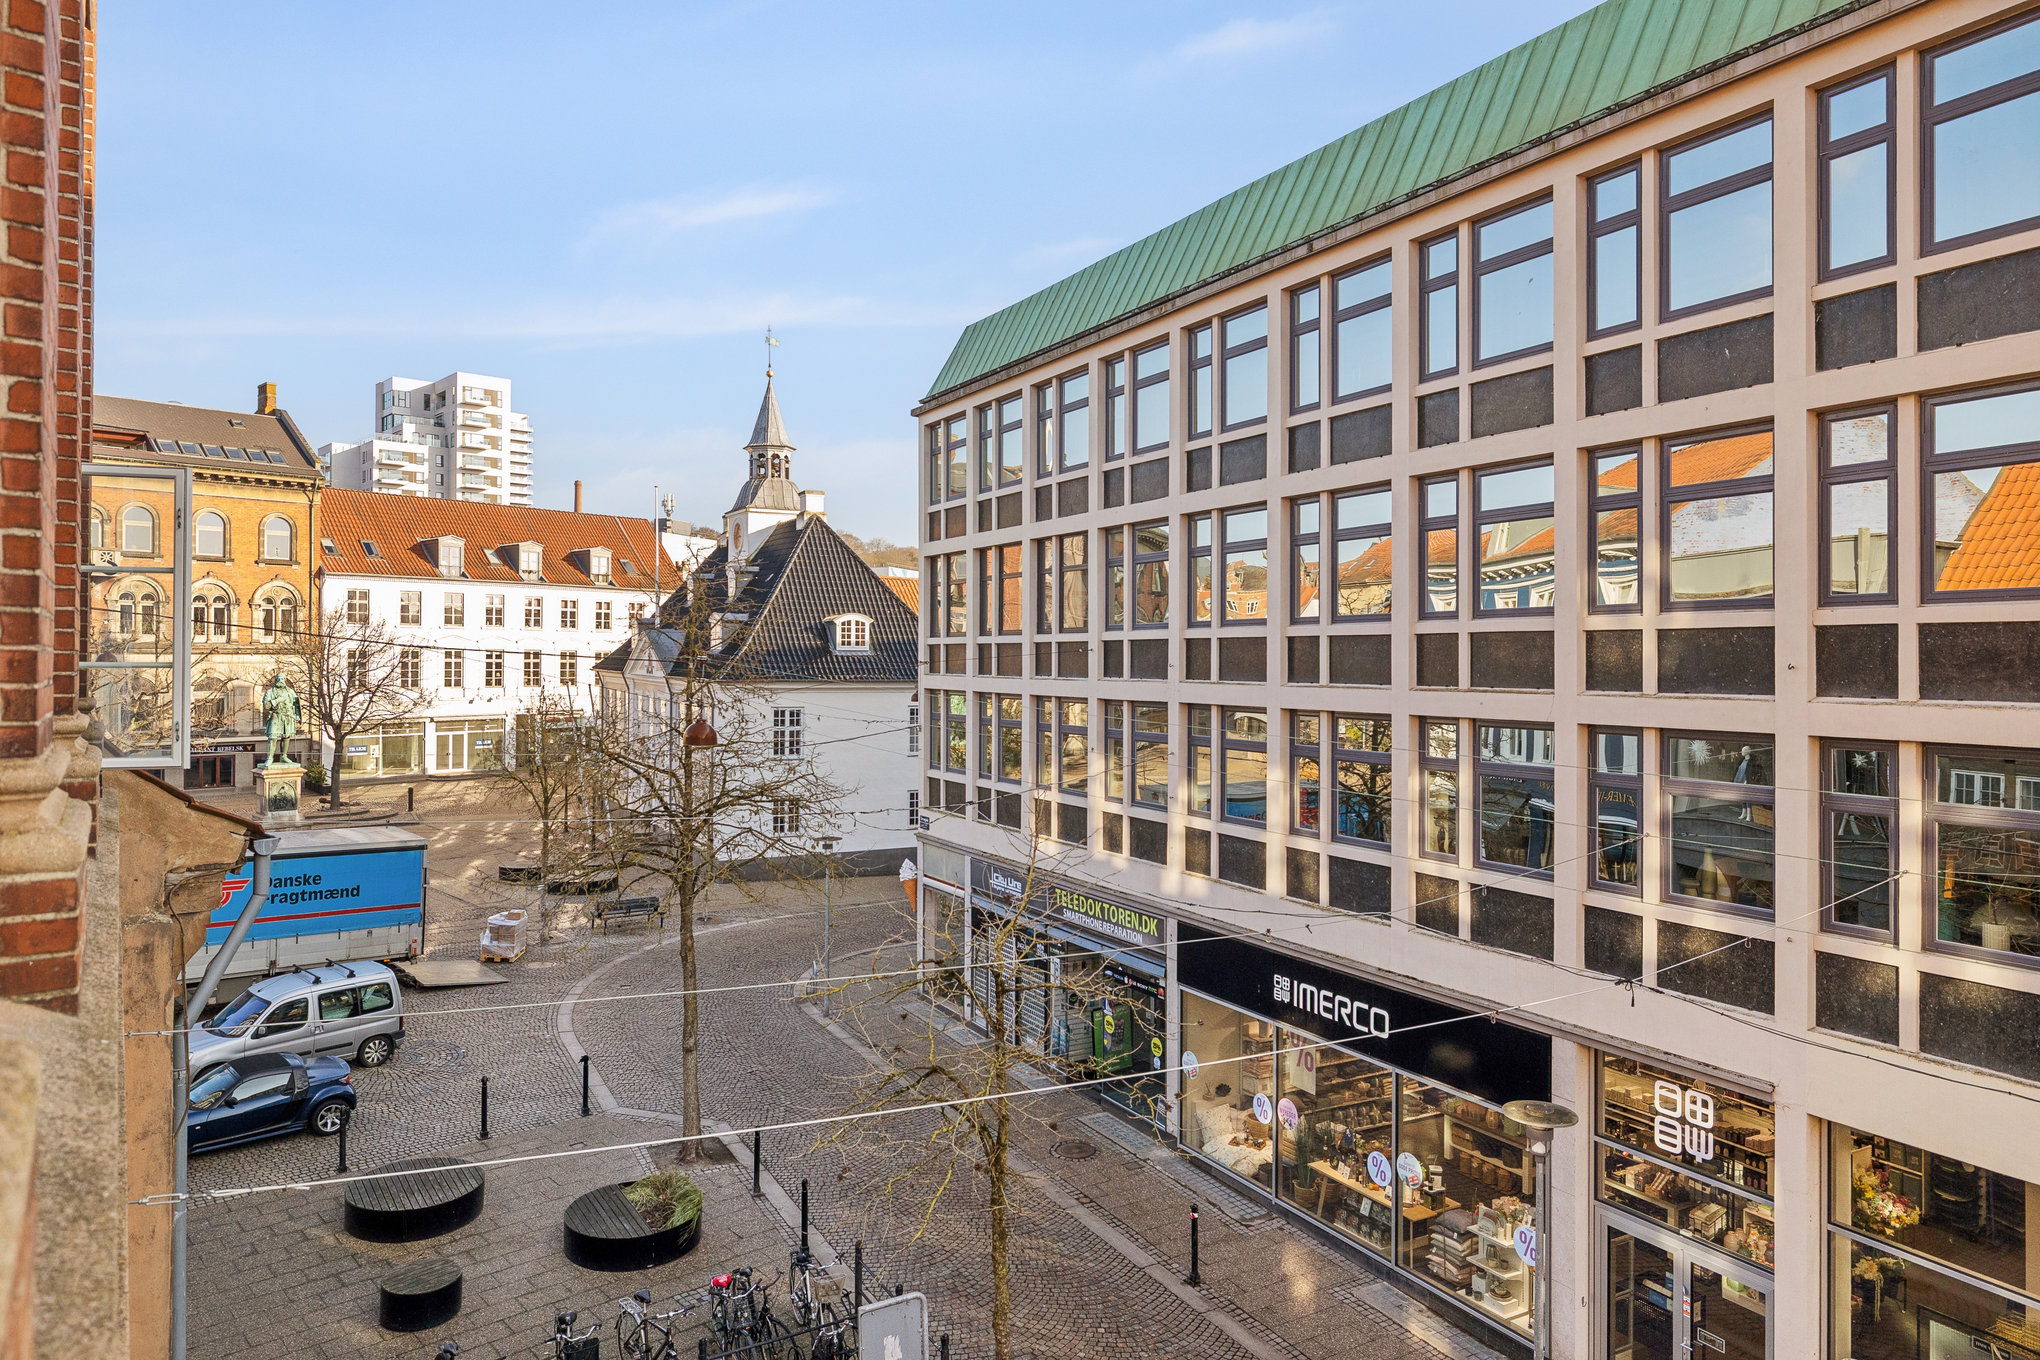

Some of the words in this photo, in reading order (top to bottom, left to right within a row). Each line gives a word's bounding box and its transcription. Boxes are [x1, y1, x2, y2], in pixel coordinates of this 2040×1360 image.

[267, 885, 361, 905] ragtmænd
[1007, 877, 1022, 891] Ure
[1055, 888, 1158, 937] TELEDOKTOREN.DK
[1293, 980, 1389, 1039] IMERCO
